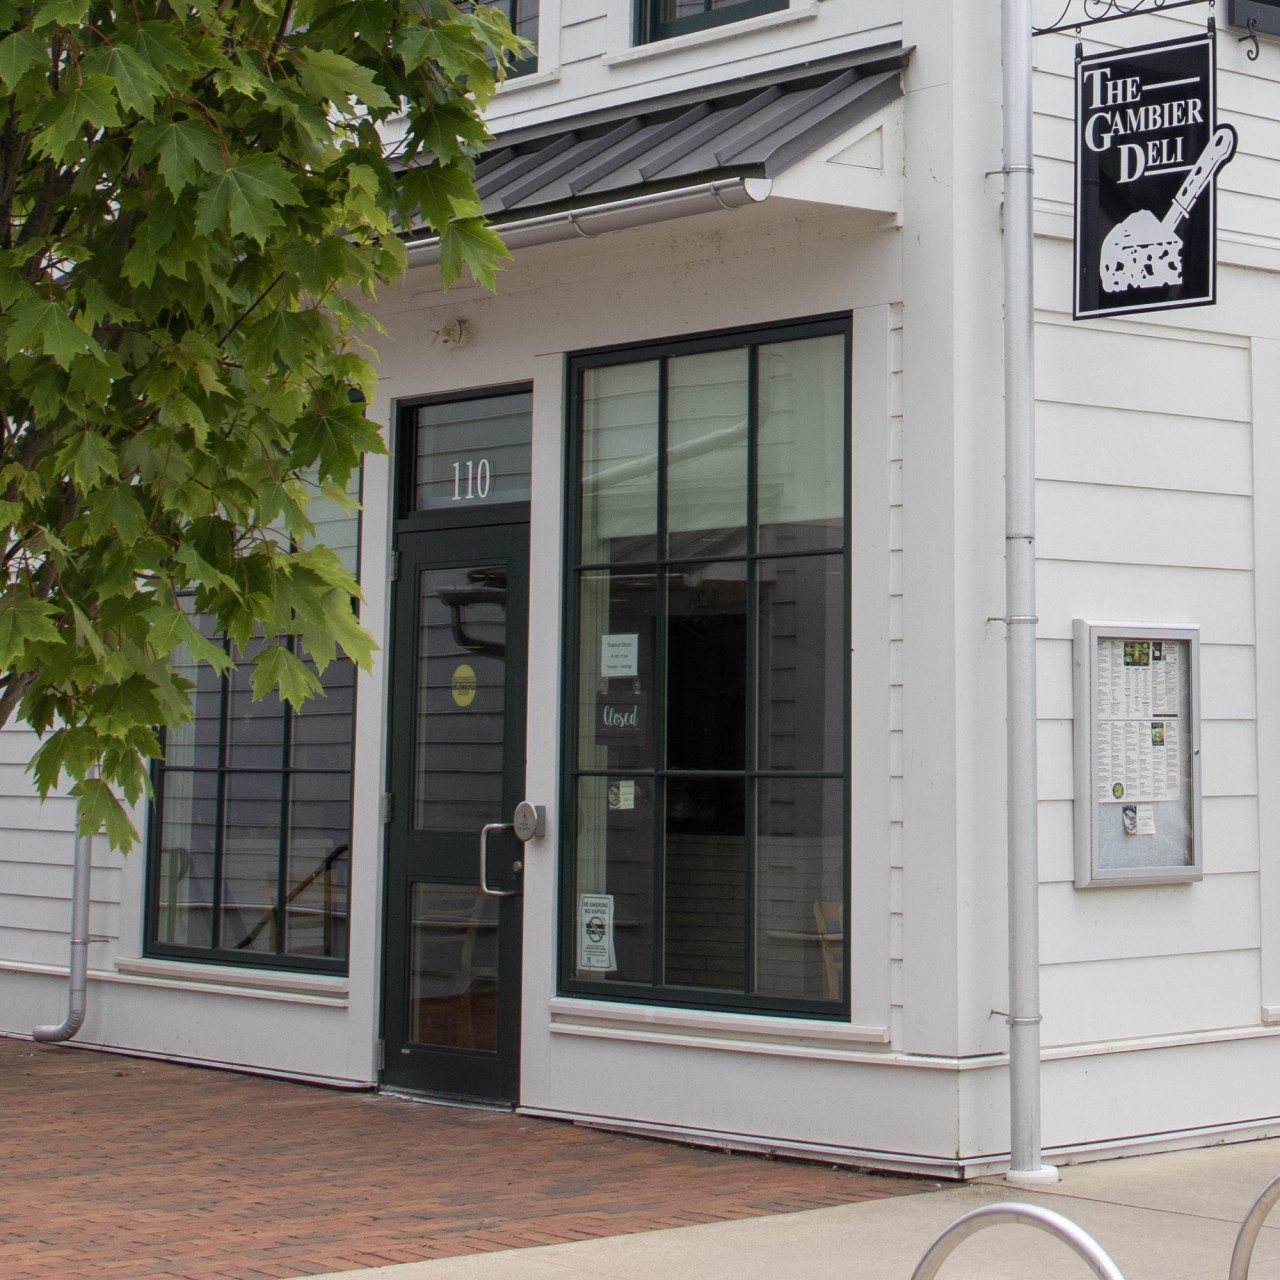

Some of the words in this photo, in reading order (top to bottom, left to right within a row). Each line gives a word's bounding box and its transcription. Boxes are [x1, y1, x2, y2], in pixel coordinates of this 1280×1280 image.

[1083, 67, 1141, 110] THE
[1085, 98, 1204, 153] GAMBIER
[1116, 136, 1184, 184] DELI
[451, 458, 490, 501] 110
[603, 704, 639, 728] Closed
